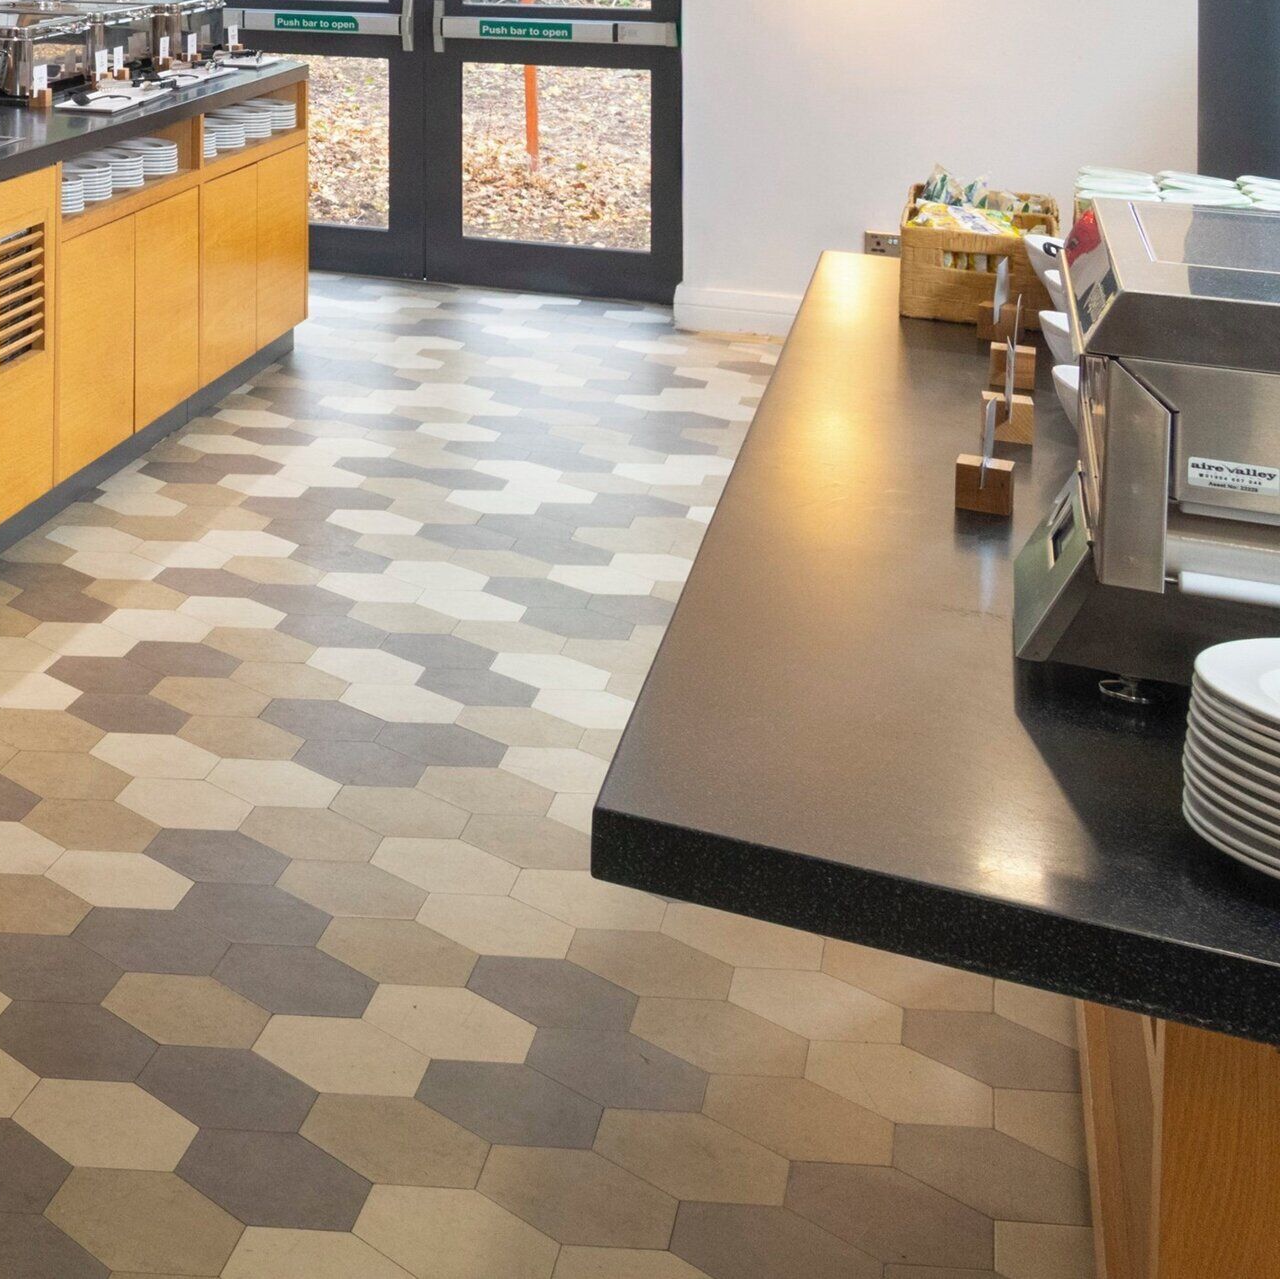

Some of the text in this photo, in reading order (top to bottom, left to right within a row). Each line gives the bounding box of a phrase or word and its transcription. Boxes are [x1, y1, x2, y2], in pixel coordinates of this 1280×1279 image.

[277, 18, 300, 26] Push
[302, 19, 317, 27] bar
[482, 25, 568, 39] Push bar to open
[1191, 462, 1224, 472] aire
